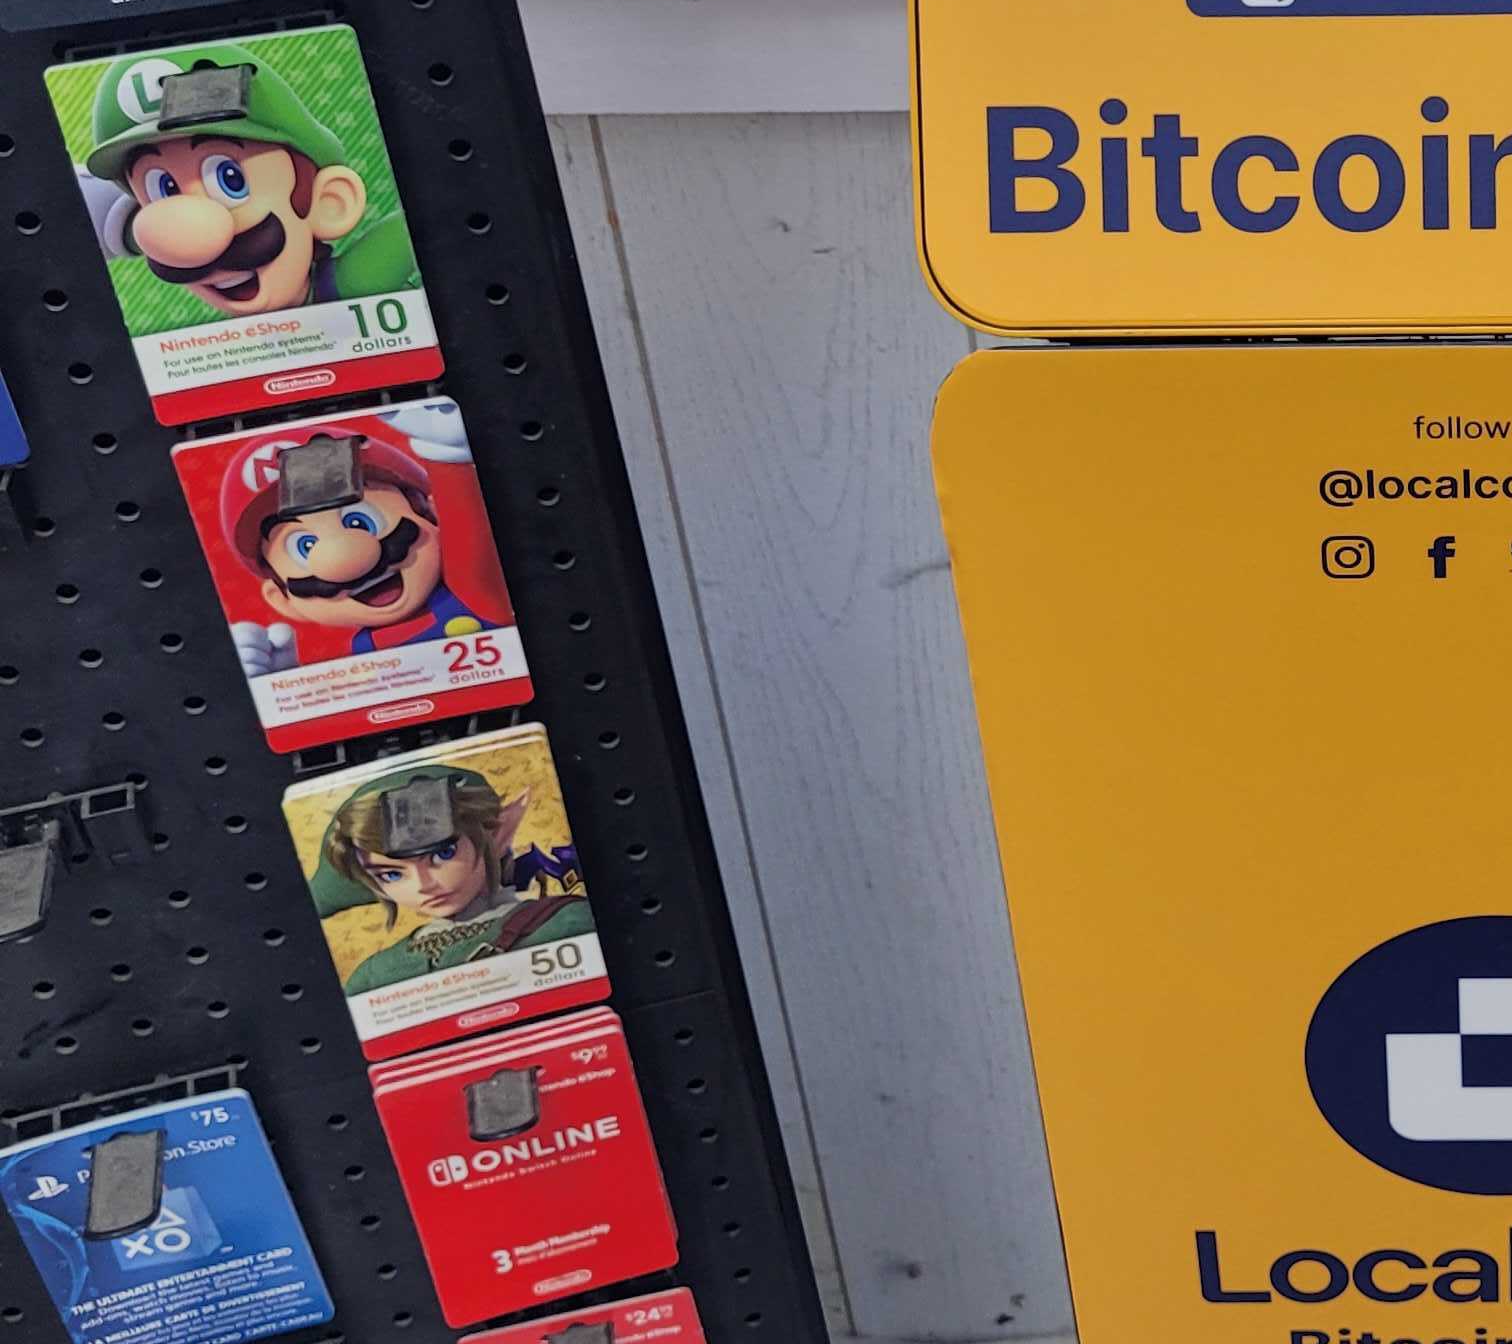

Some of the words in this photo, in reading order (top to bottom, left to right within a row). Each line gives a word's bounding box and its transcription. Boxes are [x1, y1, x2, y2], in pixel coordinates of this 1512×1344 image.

[347, 297, 409, 339] 10
[160, 330, 241, 354] Nintendo
[245, 319, 302, 340] eShop
[352, 334, 413, 354] dollars
[1412, 414, 1511, 441] follow
[443, 635, 503, 673] 25
[272, 668, 346, 692] Nintendo
[450, 666, 506, 685] dollars
[530, 942, 583, 977] 50
[190, 1106, 230, 1128] $75
[187, 1134, 237, 1155] Store
[471, 1115, 621, 1173] ONLINE
[491, 1249, 514, 1275] 3
